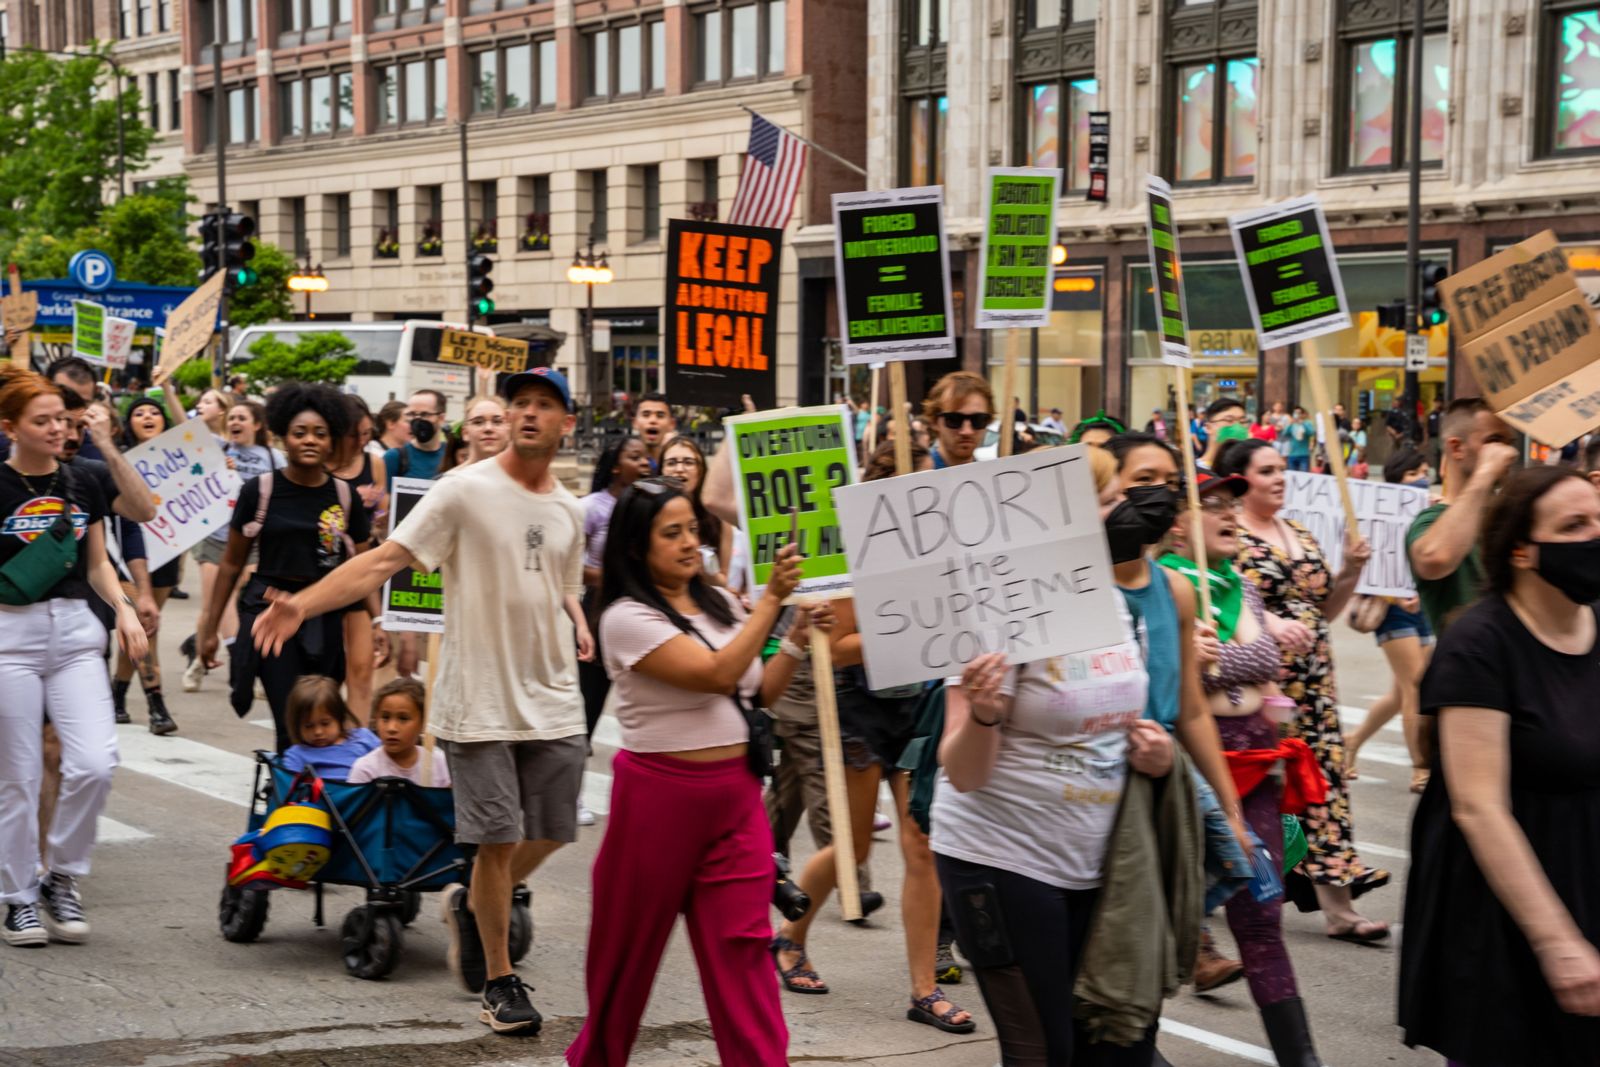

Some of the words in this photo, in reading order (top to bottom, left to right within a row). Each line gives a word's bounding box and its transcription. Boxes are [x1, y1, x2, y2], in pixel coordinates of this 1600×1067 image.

[862, 213, 916, 234] FORCED
[678, 230, 773, 284] KEEP
[844, 235, 938, 259] MOTHERHOOD
[85, 259, 104, 284] P
[675, 283, 769, 314] ABORTION
[867, 292, 923, 313] FEMALE
[449, 332, 477, 347] LET
[485, 340, 526, 356] WOMEN
[453, 346, 524, 372] DECIDE!
[675, 311, 769, 371] LEGAL
[739, 421, 843, 459] OVERTURN
[136, 447, 189, 489] Body
[165, 471, 230, 525] CHOICE
[855, 456, 1083, 570] ABORT
[939, 552, 1017, 590] the
[874, 565, 1098, 635] SUPREME
[920, 609, 1054, 669] COURT
